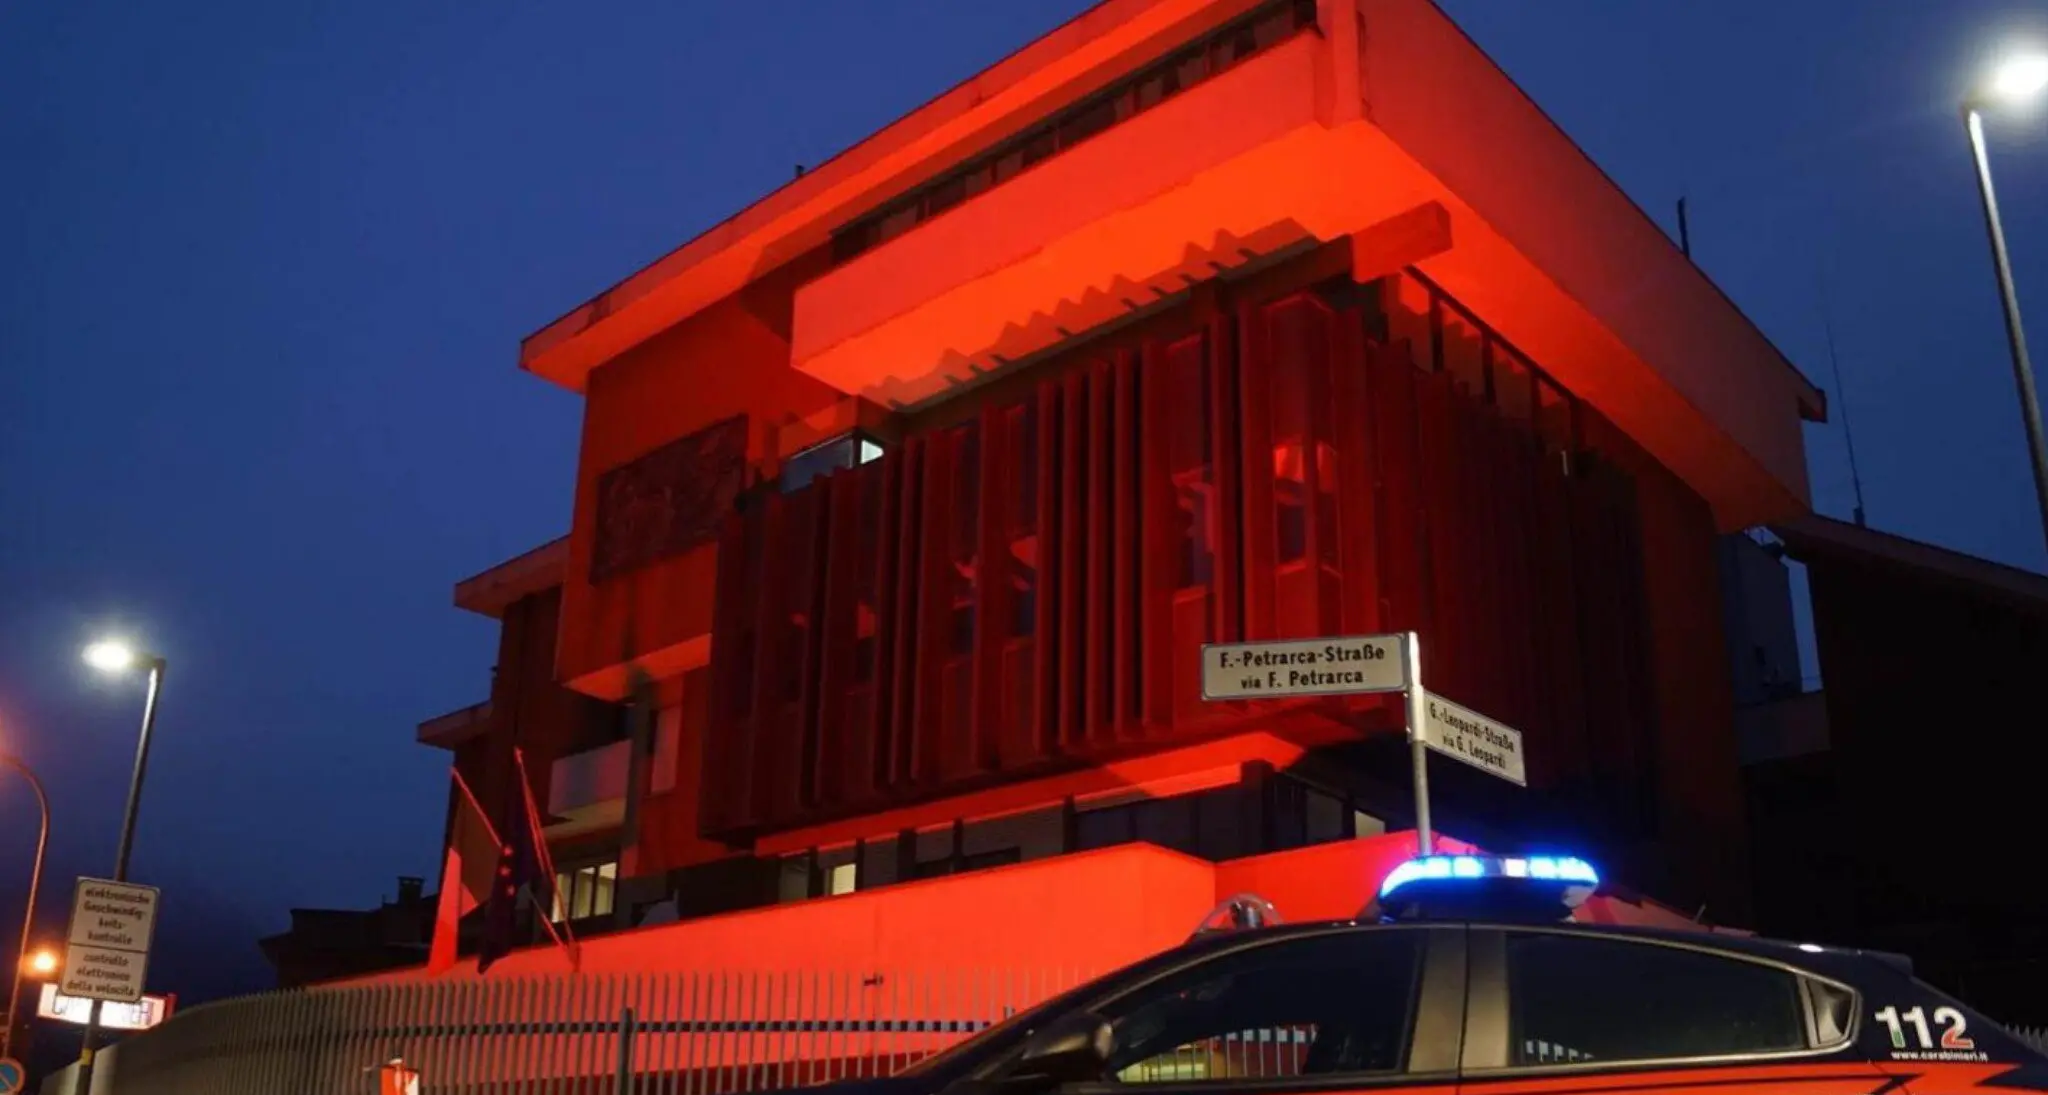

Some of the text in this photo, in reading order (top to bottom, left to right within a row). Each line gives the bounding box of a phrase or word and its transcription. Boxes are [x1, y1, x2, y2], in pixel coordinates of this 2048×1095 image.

[1219, 644, 1385, 669] F.-Petrarca-Straße
[1240, 670, 1364, 689] via F. Petrarca
[88, 930, 133, 945] kontrolle
[66, 980, 92, 992] della
[1874, 1006, 1974, 1049] 112
